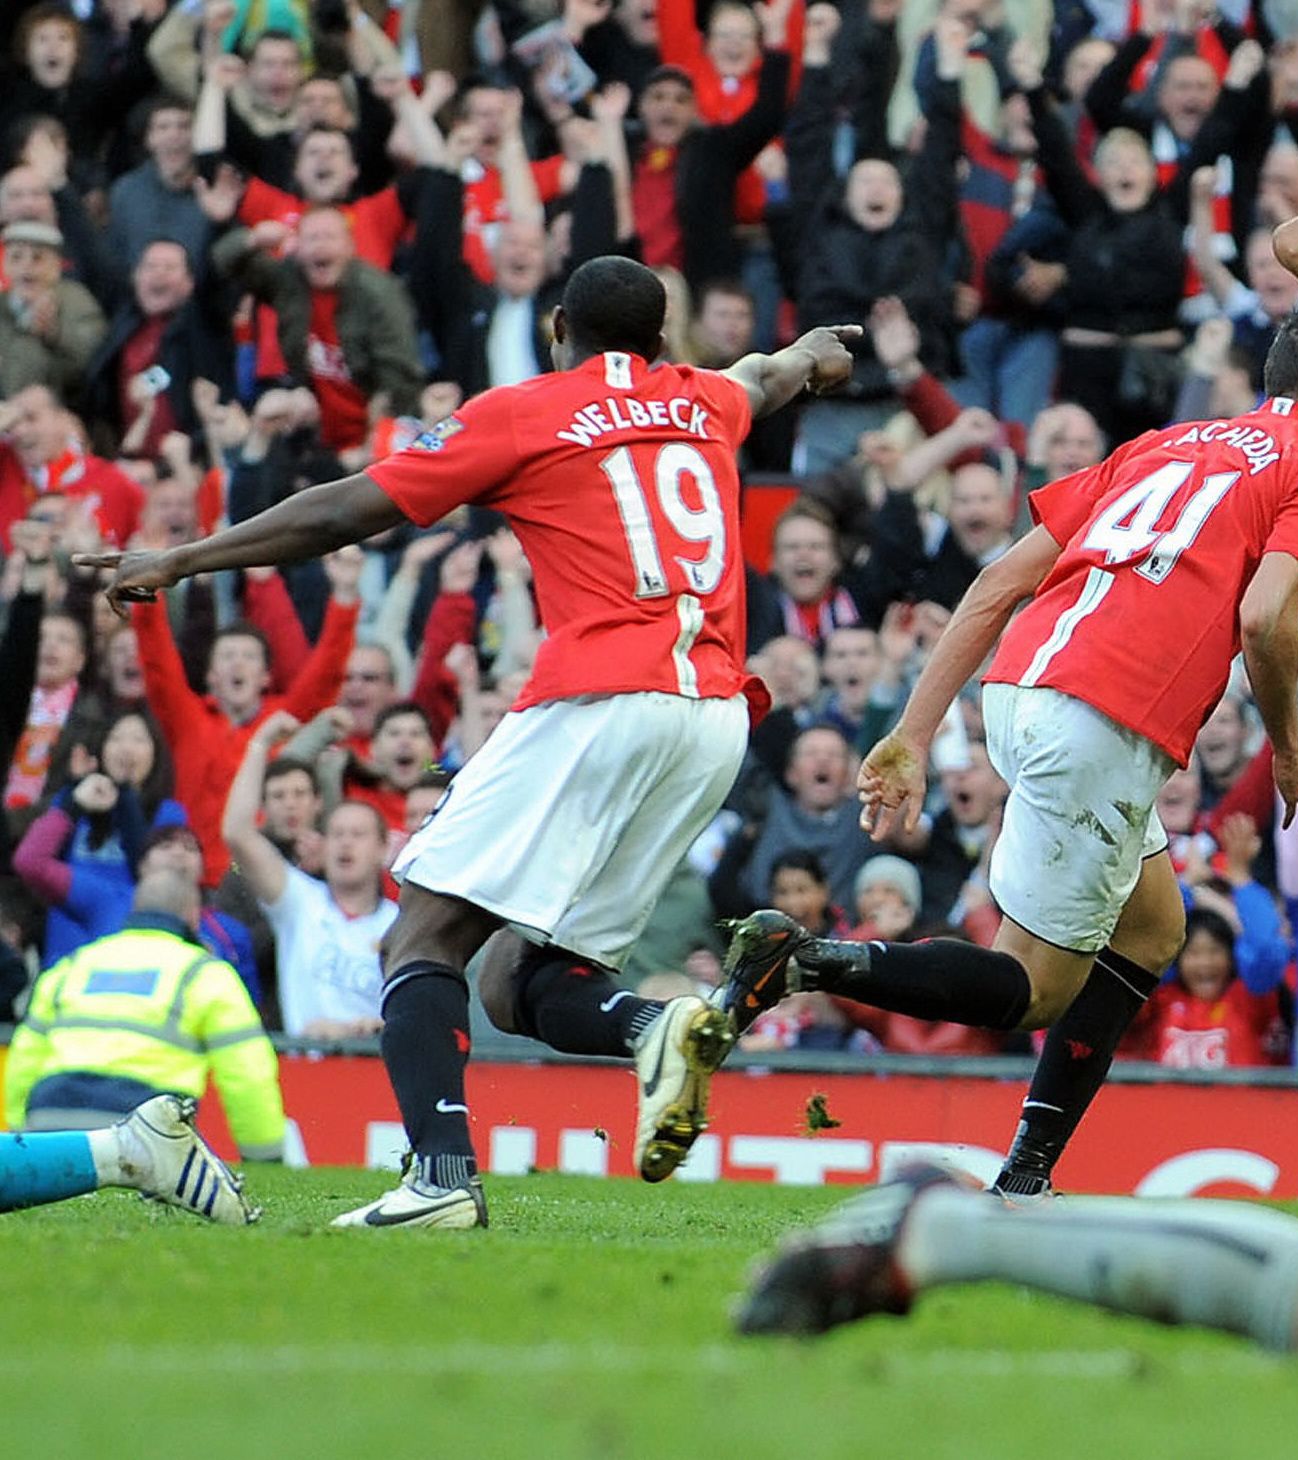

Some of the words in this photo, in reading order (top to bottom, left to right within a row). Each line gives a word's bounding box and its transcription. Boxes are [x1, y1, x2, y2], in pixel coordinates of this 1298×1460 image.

[556, 397, 709, 448] WELBECK
[1163, 422, 1281, 476] ACHEDA
[599, 441, 727, 600] 19
[1081, 460, 1242, 585] 41
